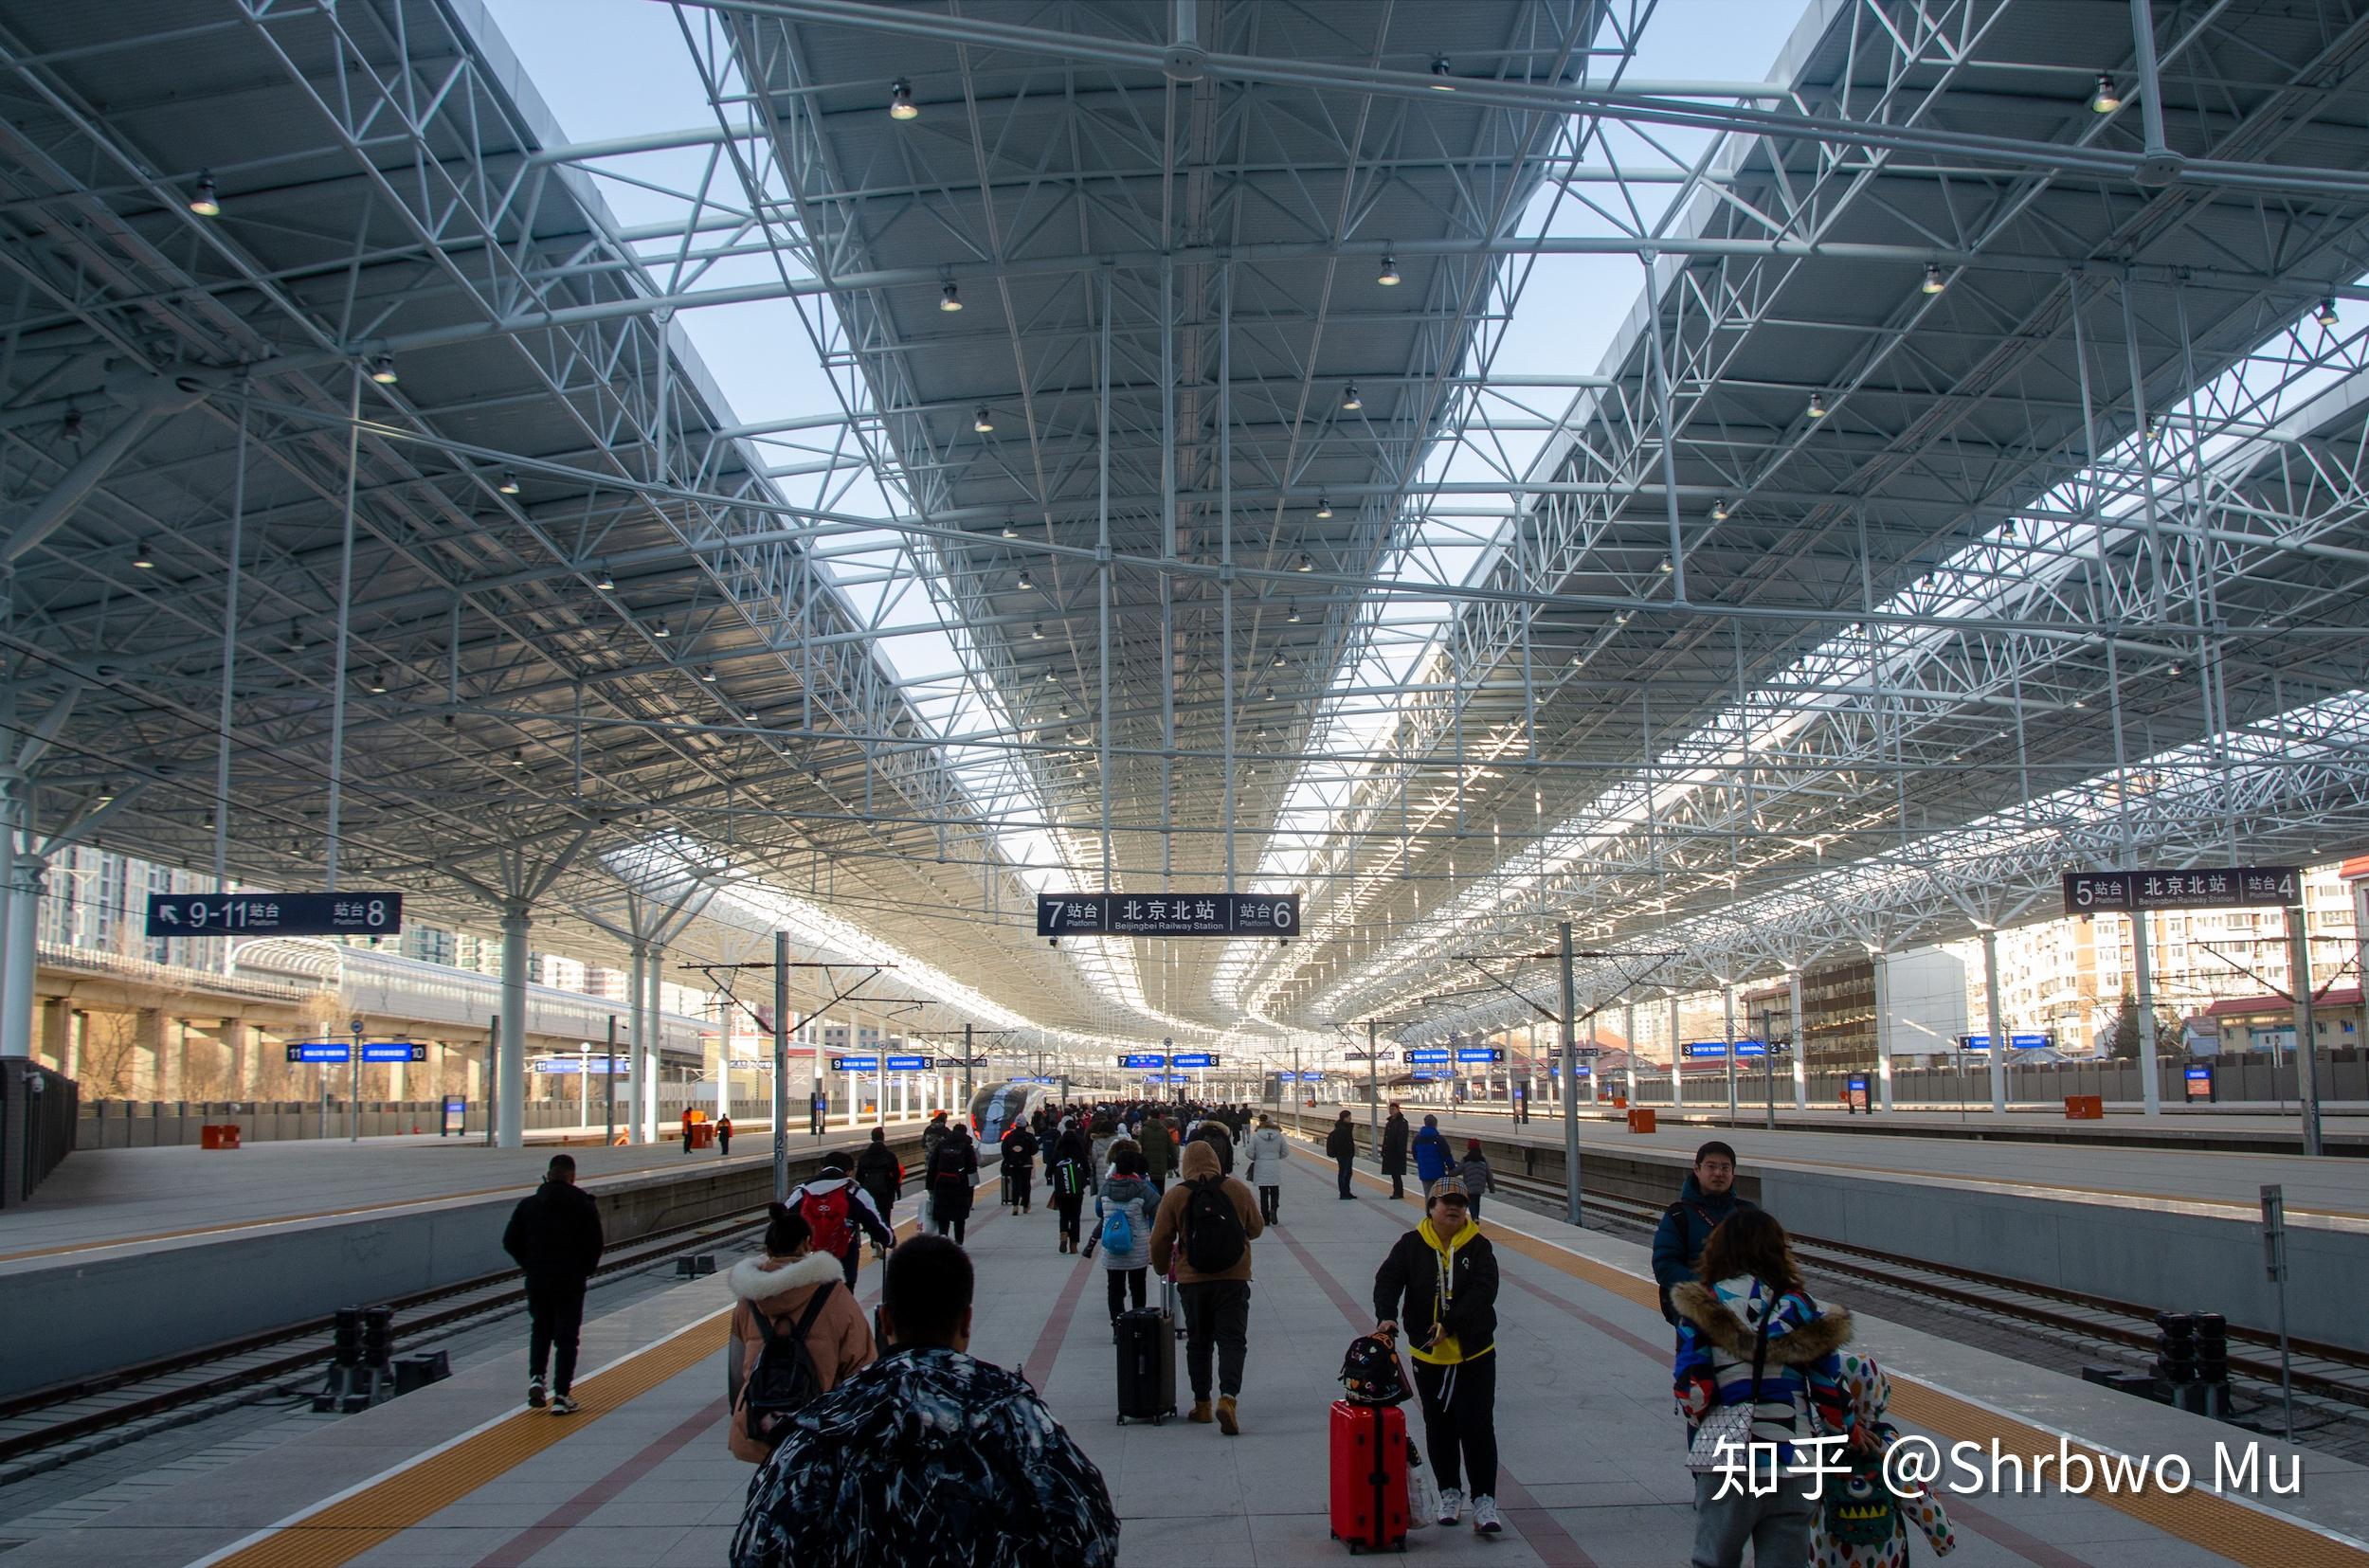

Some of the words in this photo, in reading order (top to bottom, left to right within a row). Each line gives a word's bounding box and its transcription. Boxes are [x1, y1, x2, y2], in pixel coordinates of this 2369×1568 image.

[2144, 874, 2227, 896] 北京北站
[2248, 876, 2276, 892] 站台
[2278, 874, 2294, 899] 4
[2076, 879, 2093, 906] 5
[2094, 881, 2123, 896] 站台
[2178, 895, 2208, 906] Railway
[2209, 894, 2235, 904] Station
[189, 901, 246, 928] 9-11
[249, 903, 280, 918] 站台
[334, 902, 364, 917] 站台
[367, 899, 386, 927] 8
[1045, 901, 1064, 928] 7
[1066, 903, 1098, 919] 站台
[1123, 900, 1216, 921] 北京北站
[1240, 903, 1272, 919] 站台
[1273, 901, 1292, 928] 6
[1066, 919, 1097, 928] Platform
[1114, 922, 1157, 931] Beijingbei
[1159, 922, 1192, 931] Railway
[1193, 922, 1223, 930] Station
[1239, 919, 1271, 928] Platform
[289, 1048, 300, 1059] 11
[411, 1047, 424, 1059] 10
[1685, 1046, 1691, 1054] 3
[1120, 1057, 1127, 1066] 7
[1210, 1056, 1217, 1065] 6
[1405, 1053, 1413, 1062] 5
[1493, 1052, 1501, 1060] 4
[834, 1059, 841, 1069] 9
[924, 1058, 931, 1068] 8
